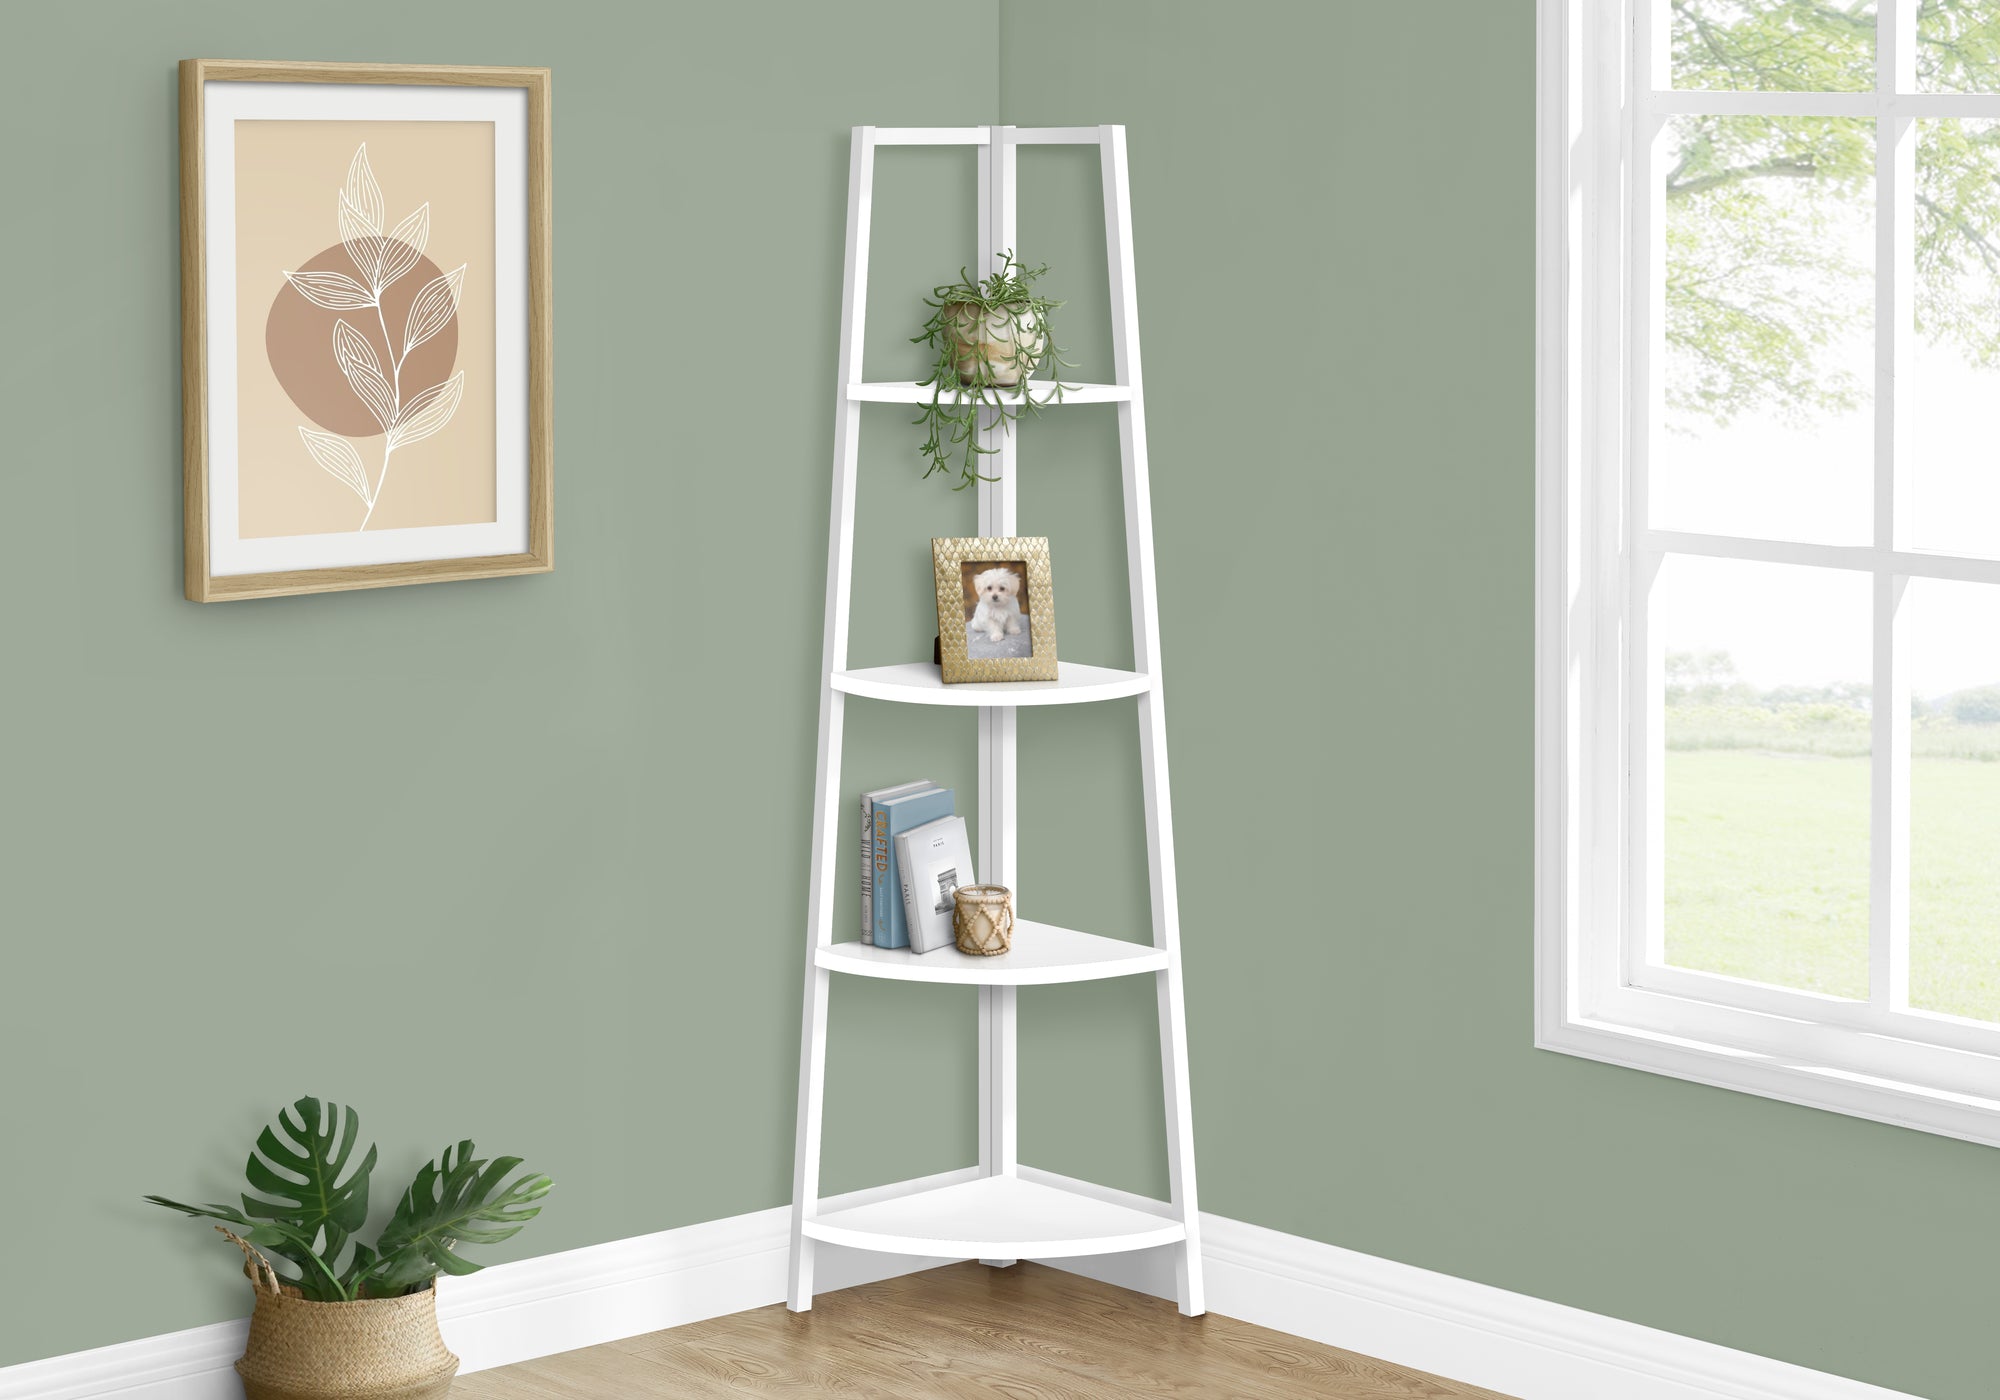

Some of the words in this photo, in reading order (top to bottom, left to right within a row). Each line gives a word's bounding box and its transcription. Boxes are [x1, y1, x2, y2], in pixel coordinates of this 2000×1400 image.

[860, 839, 871, 860] WILD
[875, 811, 888, 872] CRAFTED
[861, 874, 872, 898] HOME
